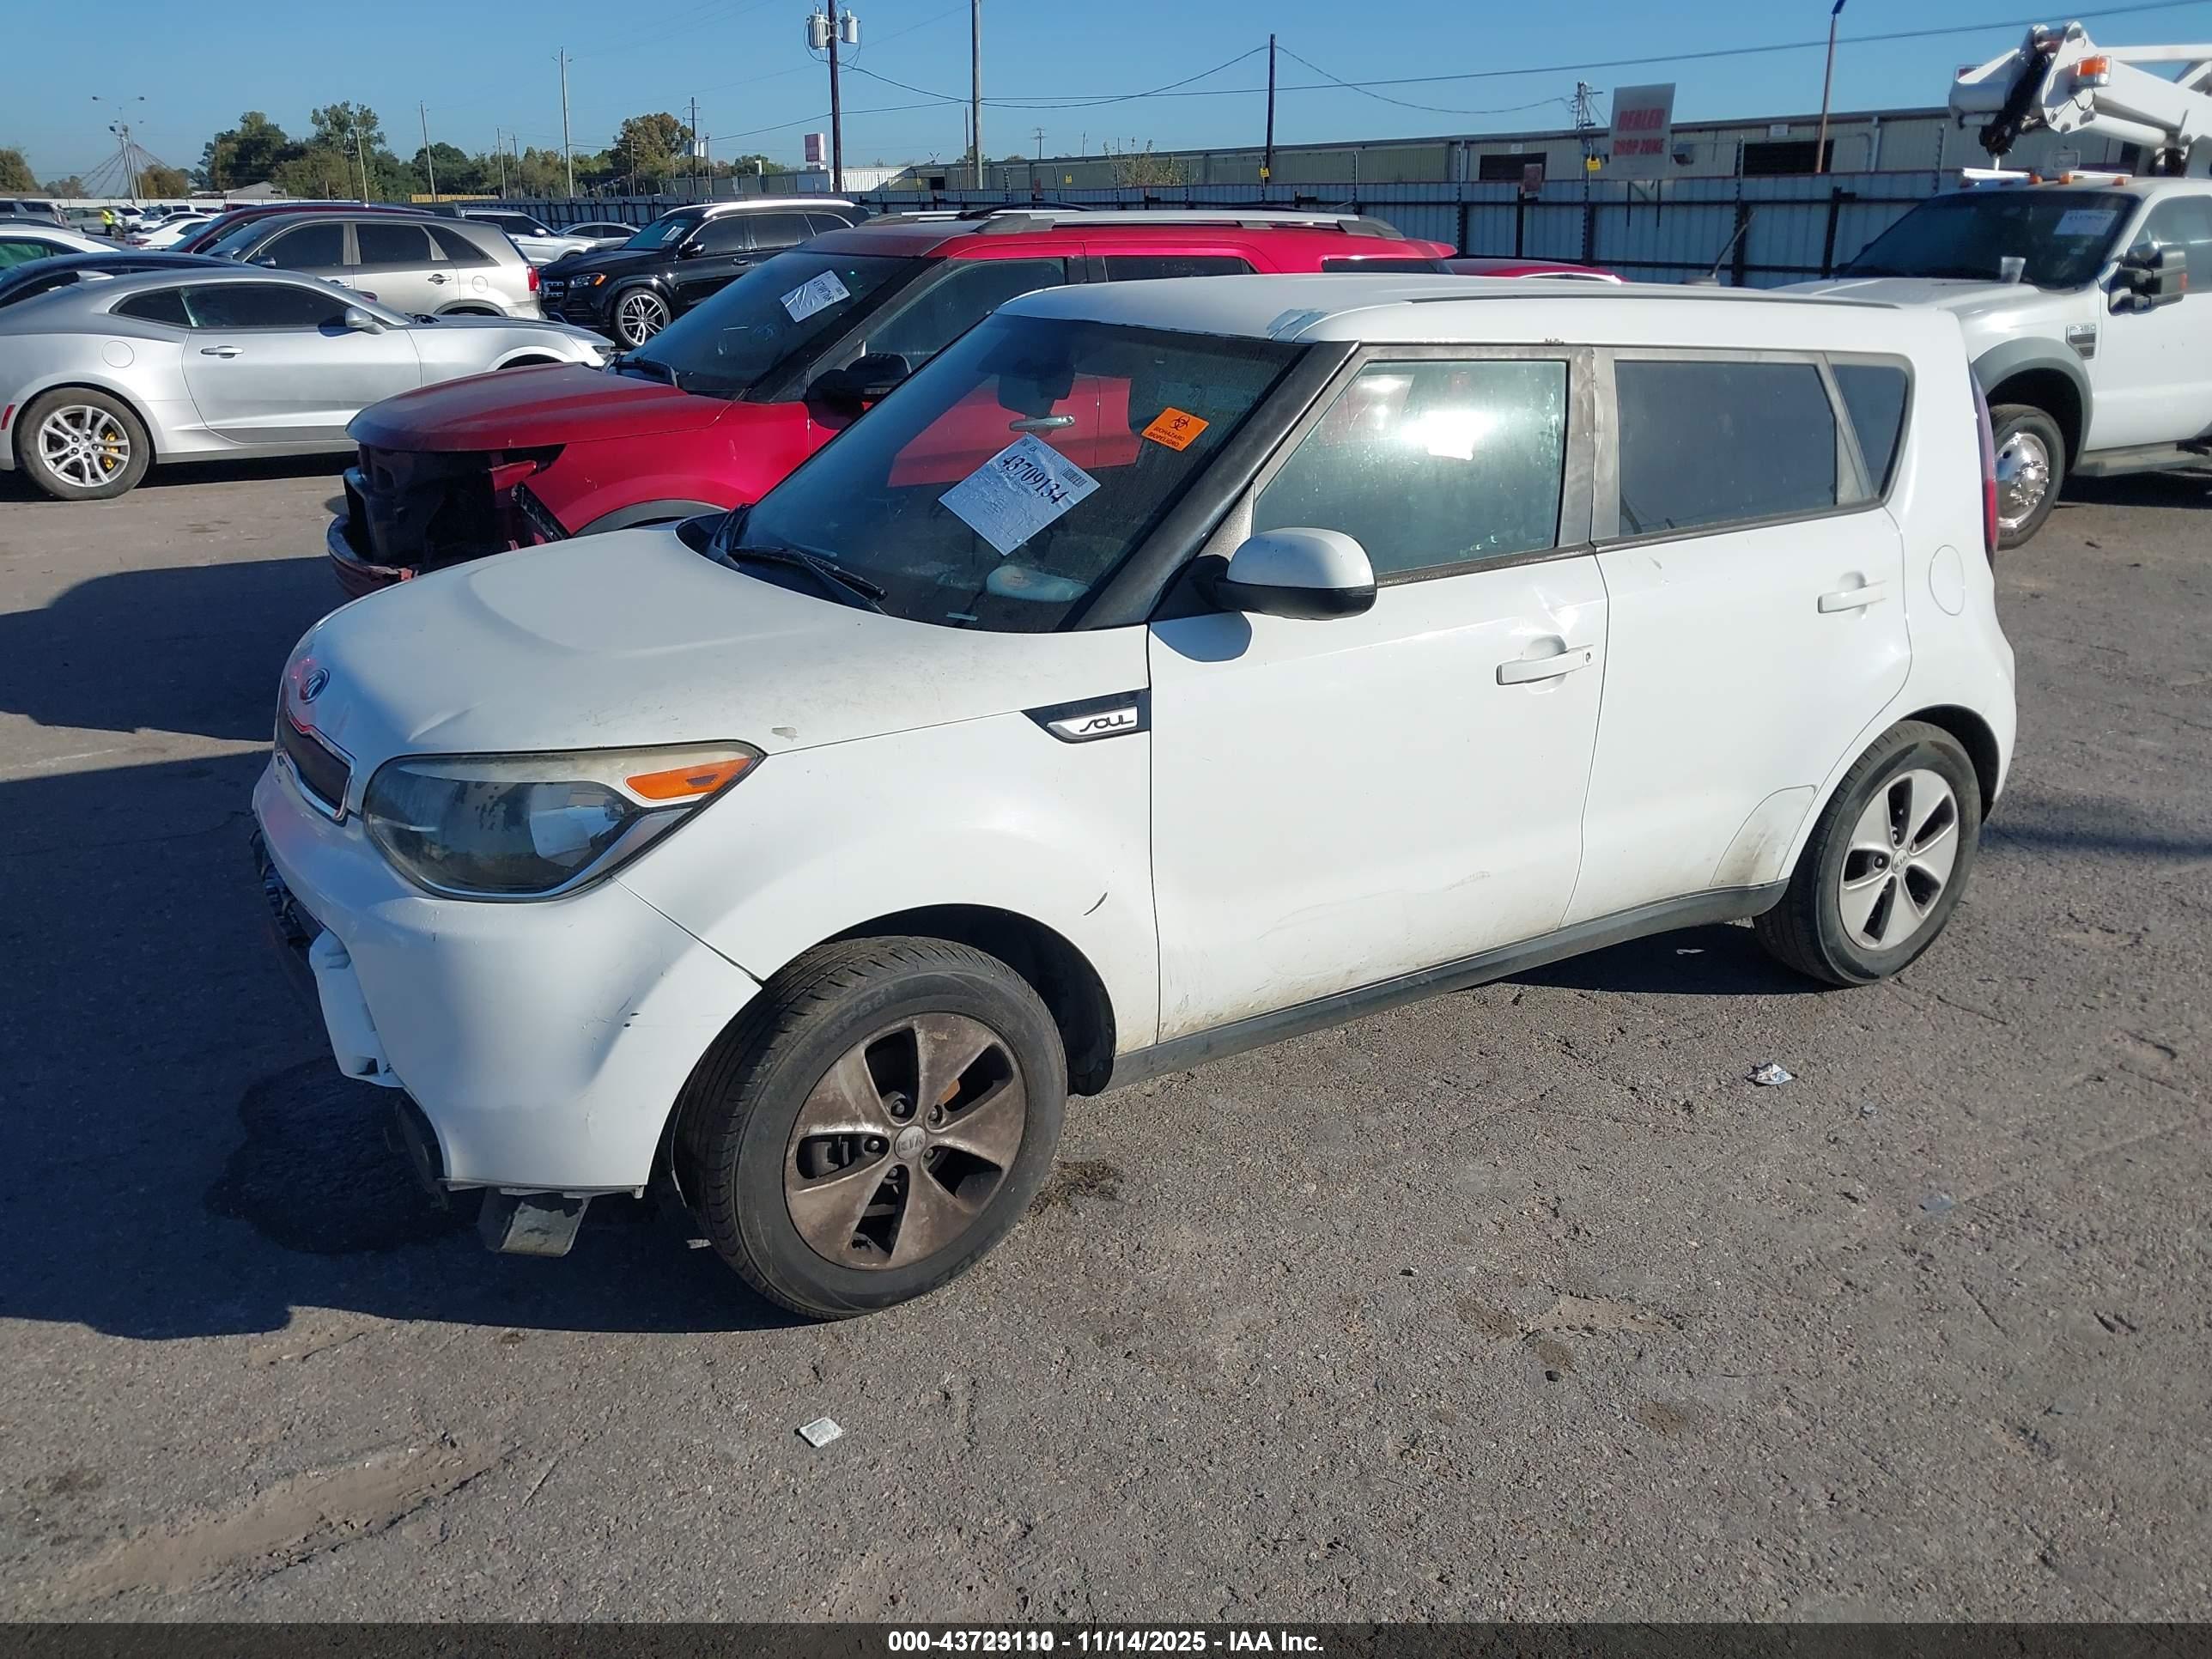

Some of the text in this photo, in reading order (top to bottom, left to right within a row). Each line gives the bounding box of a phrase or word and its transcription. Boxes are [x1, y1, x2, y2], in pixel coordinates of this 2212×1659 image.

[1613, 138, 1664, 155] DROP ZONE
[1001, 454, 1069, 505] 43709134
[1079, 714, 1134, 732] SOUL
